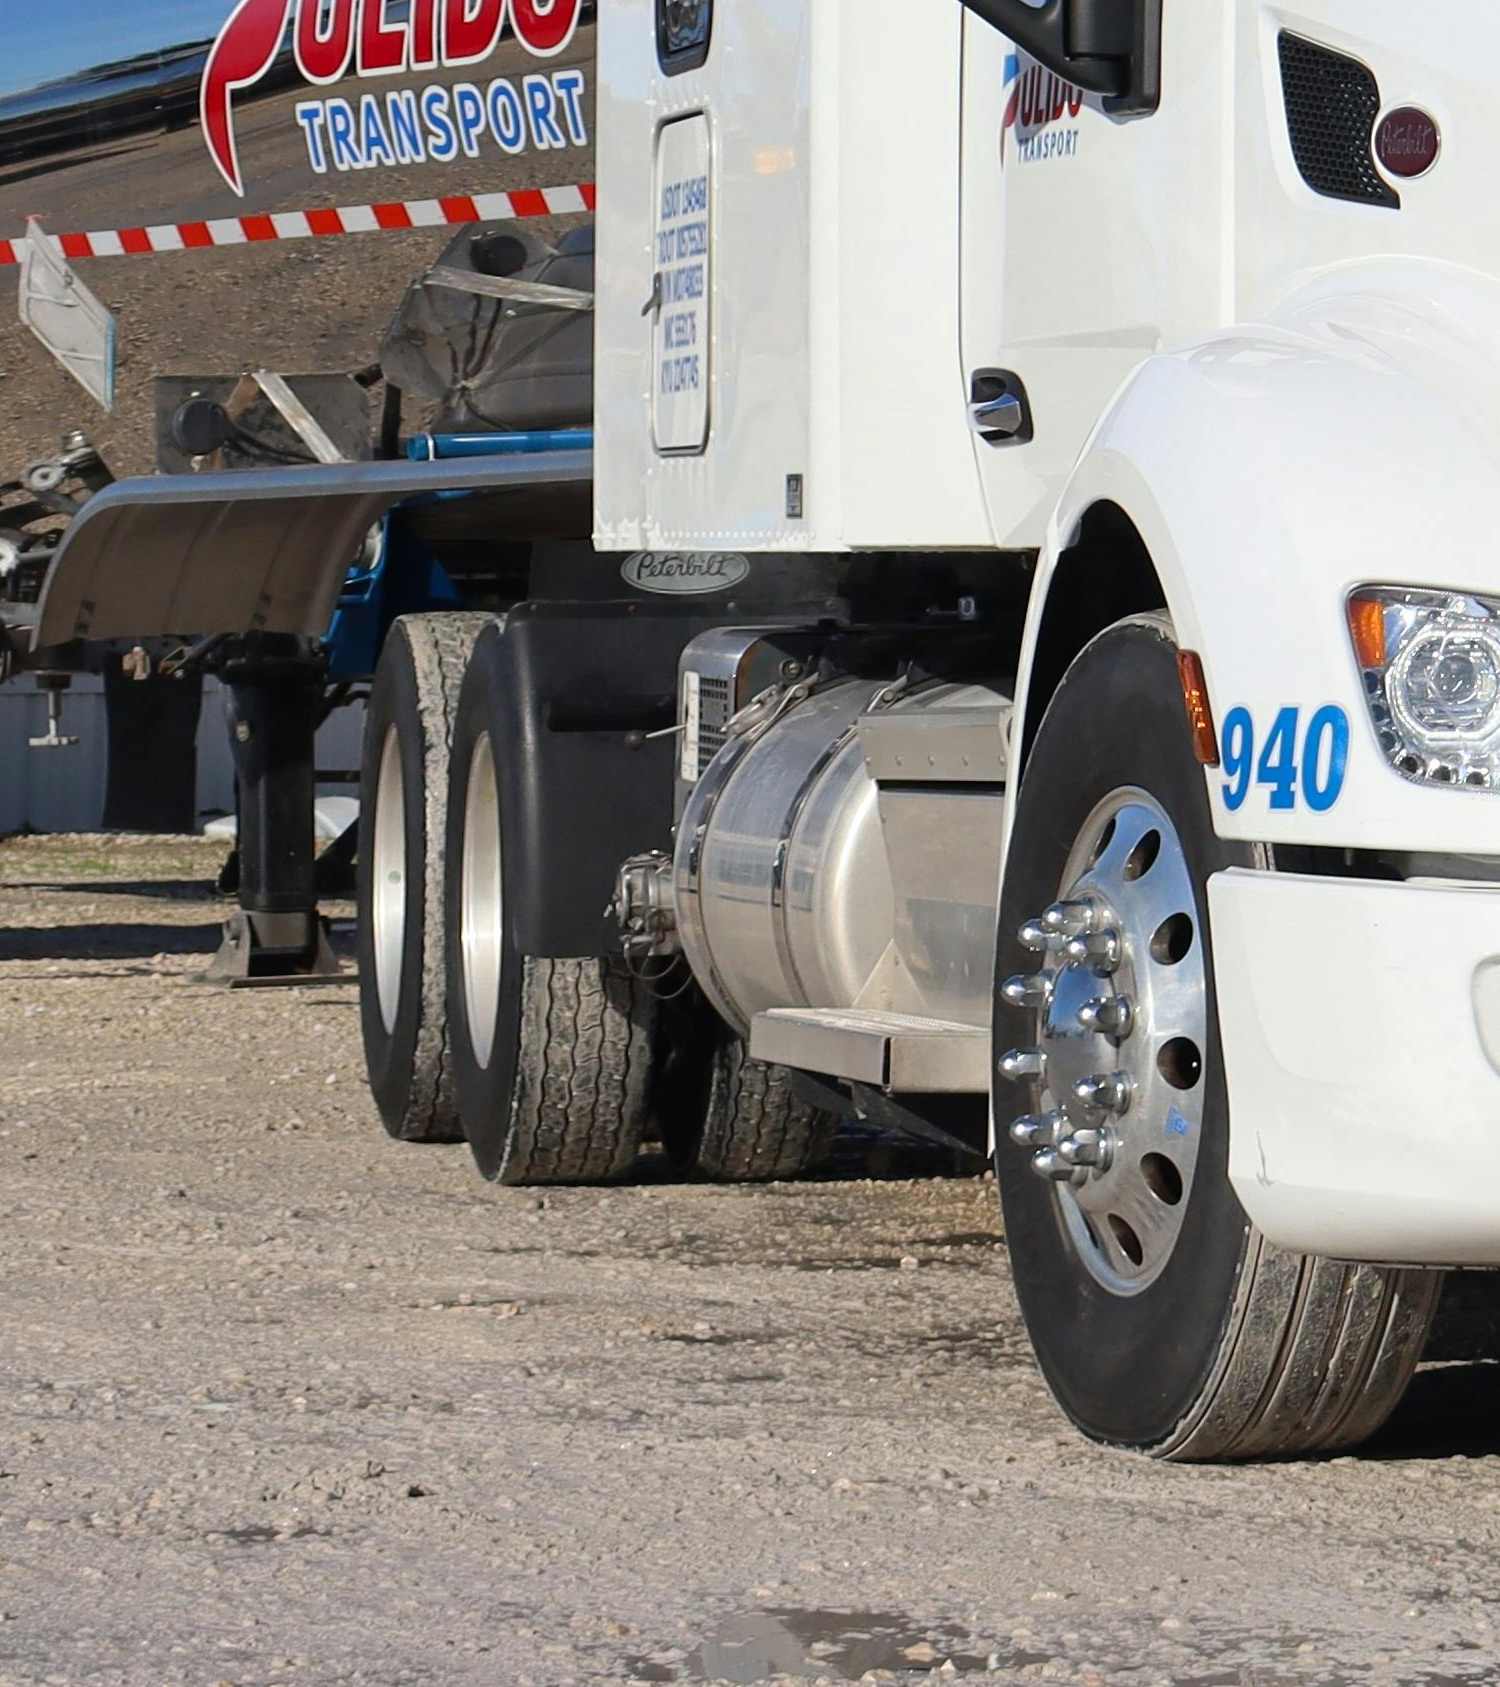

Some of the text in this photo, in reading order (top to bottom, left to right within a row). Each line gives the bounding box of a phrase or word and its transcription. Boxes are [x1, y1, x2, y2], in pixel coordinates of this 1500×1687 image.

[296, 69, 587, 174] TRANSPORT
[1018, 129, 1078, 164] TRANSPORT
[636, 551, 735, 581] Peterbilt
[1219, 703, 1351, 812] 940
